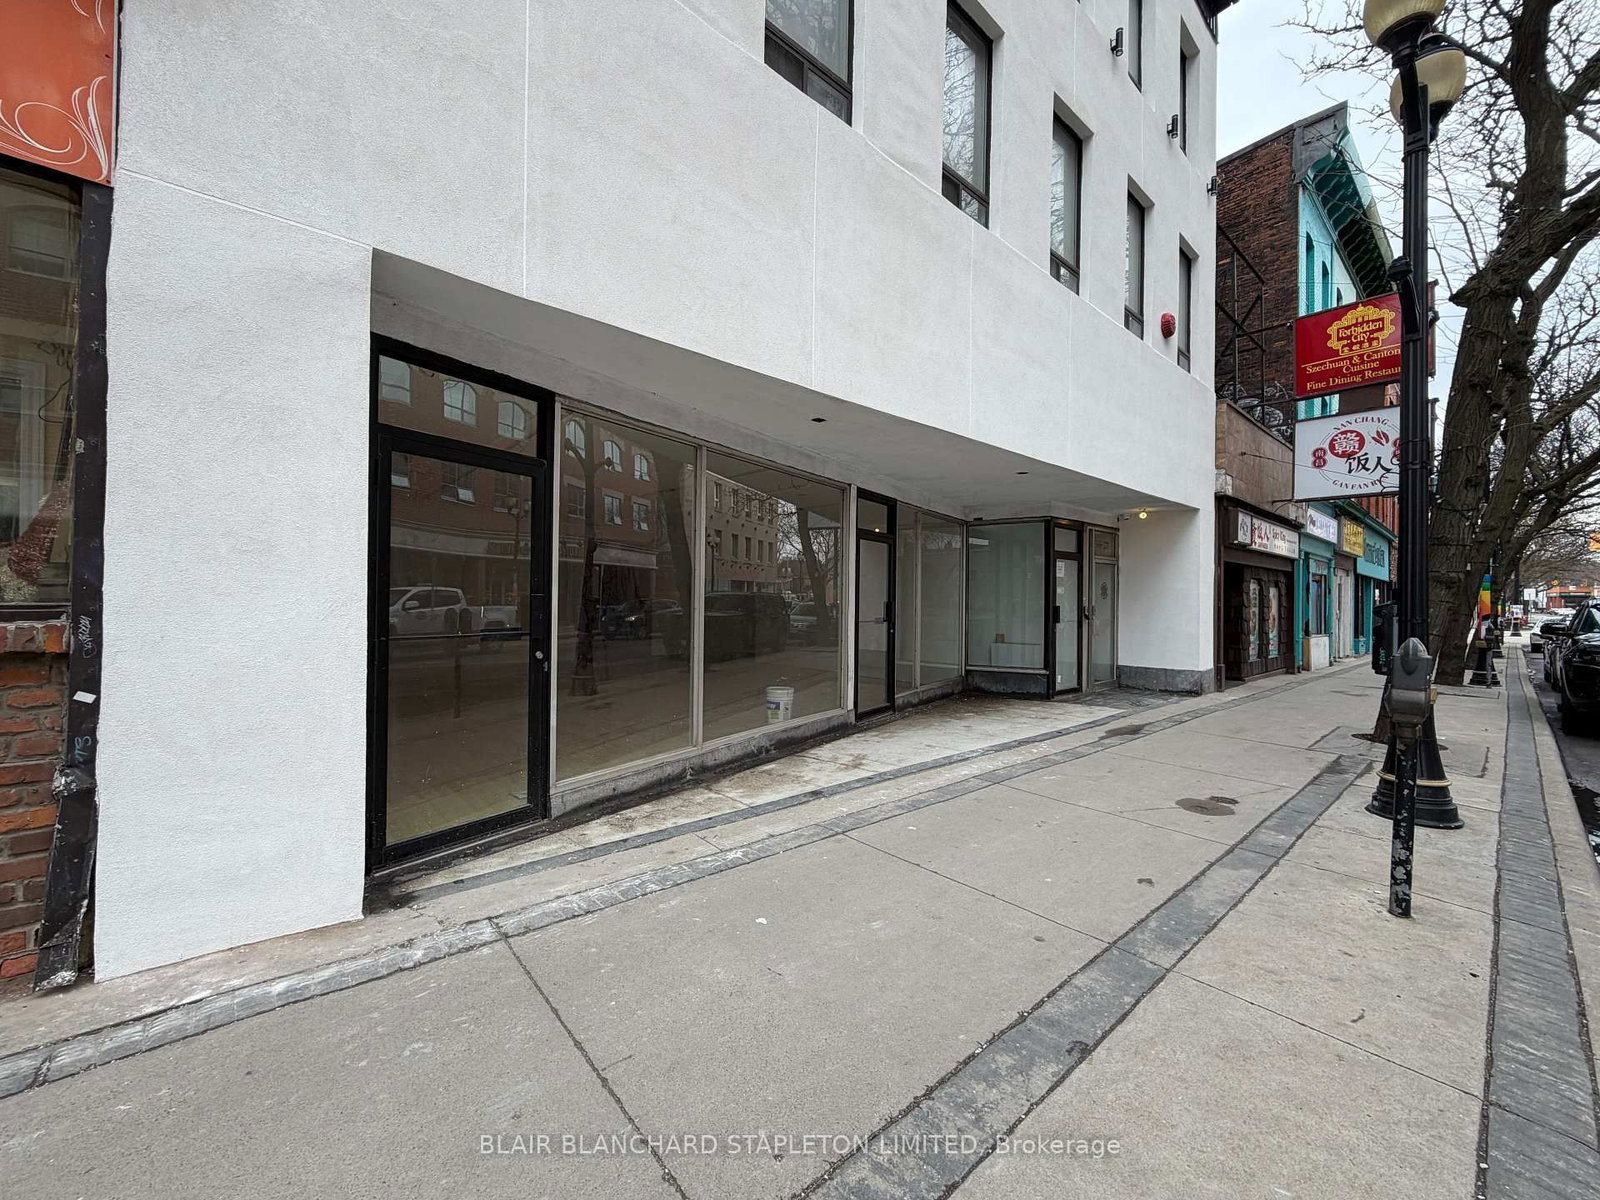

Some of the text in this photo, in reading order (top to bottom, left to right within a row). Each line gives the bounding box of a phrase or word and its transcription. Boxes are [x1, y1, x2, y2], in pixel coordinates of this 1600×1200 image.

[1338, 321, 1383, 338] Forbidden
[1351, 332, 1370, 343] City
[1306, 348, 1400, 374] Szechuan & Canton
[1342, 360, 1380, 374] Cuisine
[1306, 366, 1400, 391] Fine Dining Restau
[1333, 417, 1389, 431] NAN CHANG
[1332, 479, 1349, 489] GAN
[1351, 482, 1369, 490] FAN
